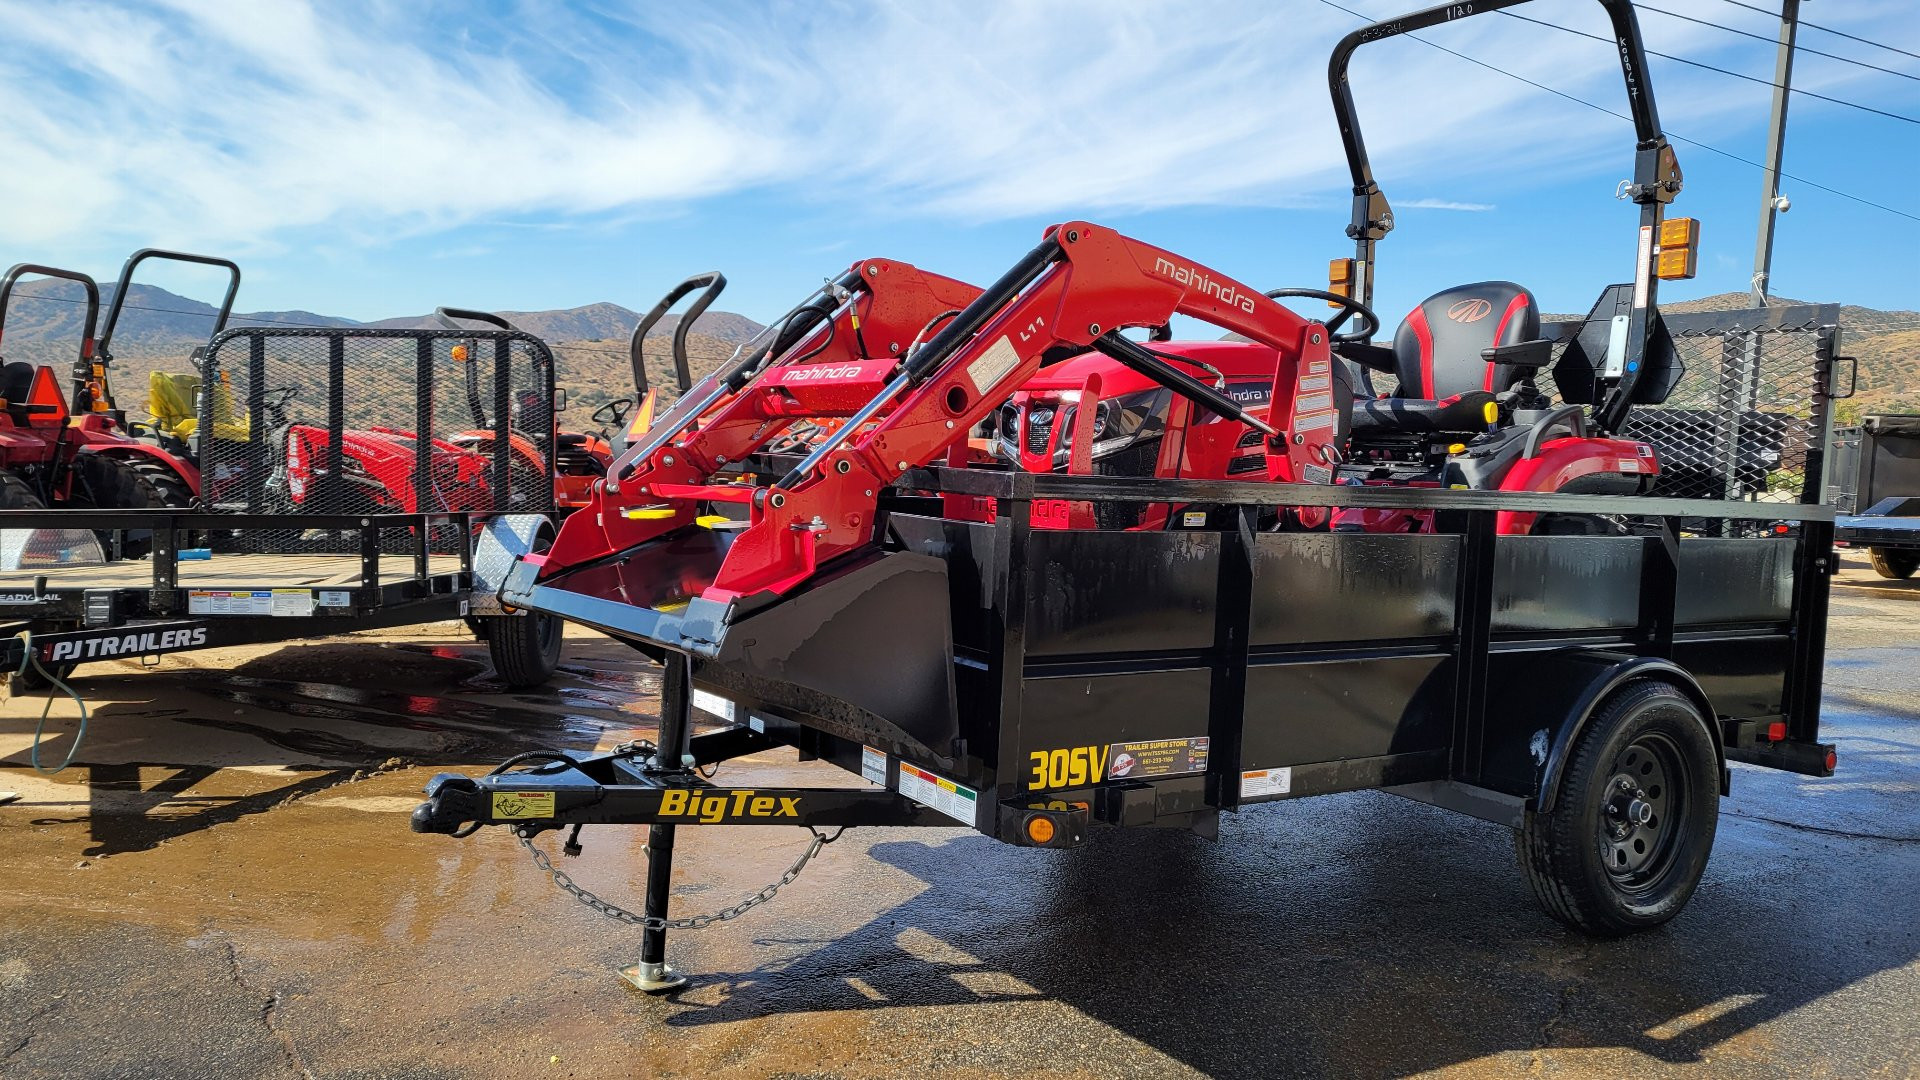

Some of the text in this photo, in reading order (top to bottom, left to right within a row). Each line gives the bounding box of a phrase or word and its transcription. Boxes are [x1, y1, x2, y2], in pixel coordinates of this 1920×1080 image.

[1446, 5, 1473, 20] 1120
[1155, 257, 1255, 314] mahindra
[1020, 316, 1045, 342] L11
[782, 364, 862, 381] mahindra
[1124, 744, 1149, 752] TRAILER
[1170, 740, 1188, 748] STORE
[1028, 745, 1109, 790] 30SV
[658, 789, 802, 823] BigTex
